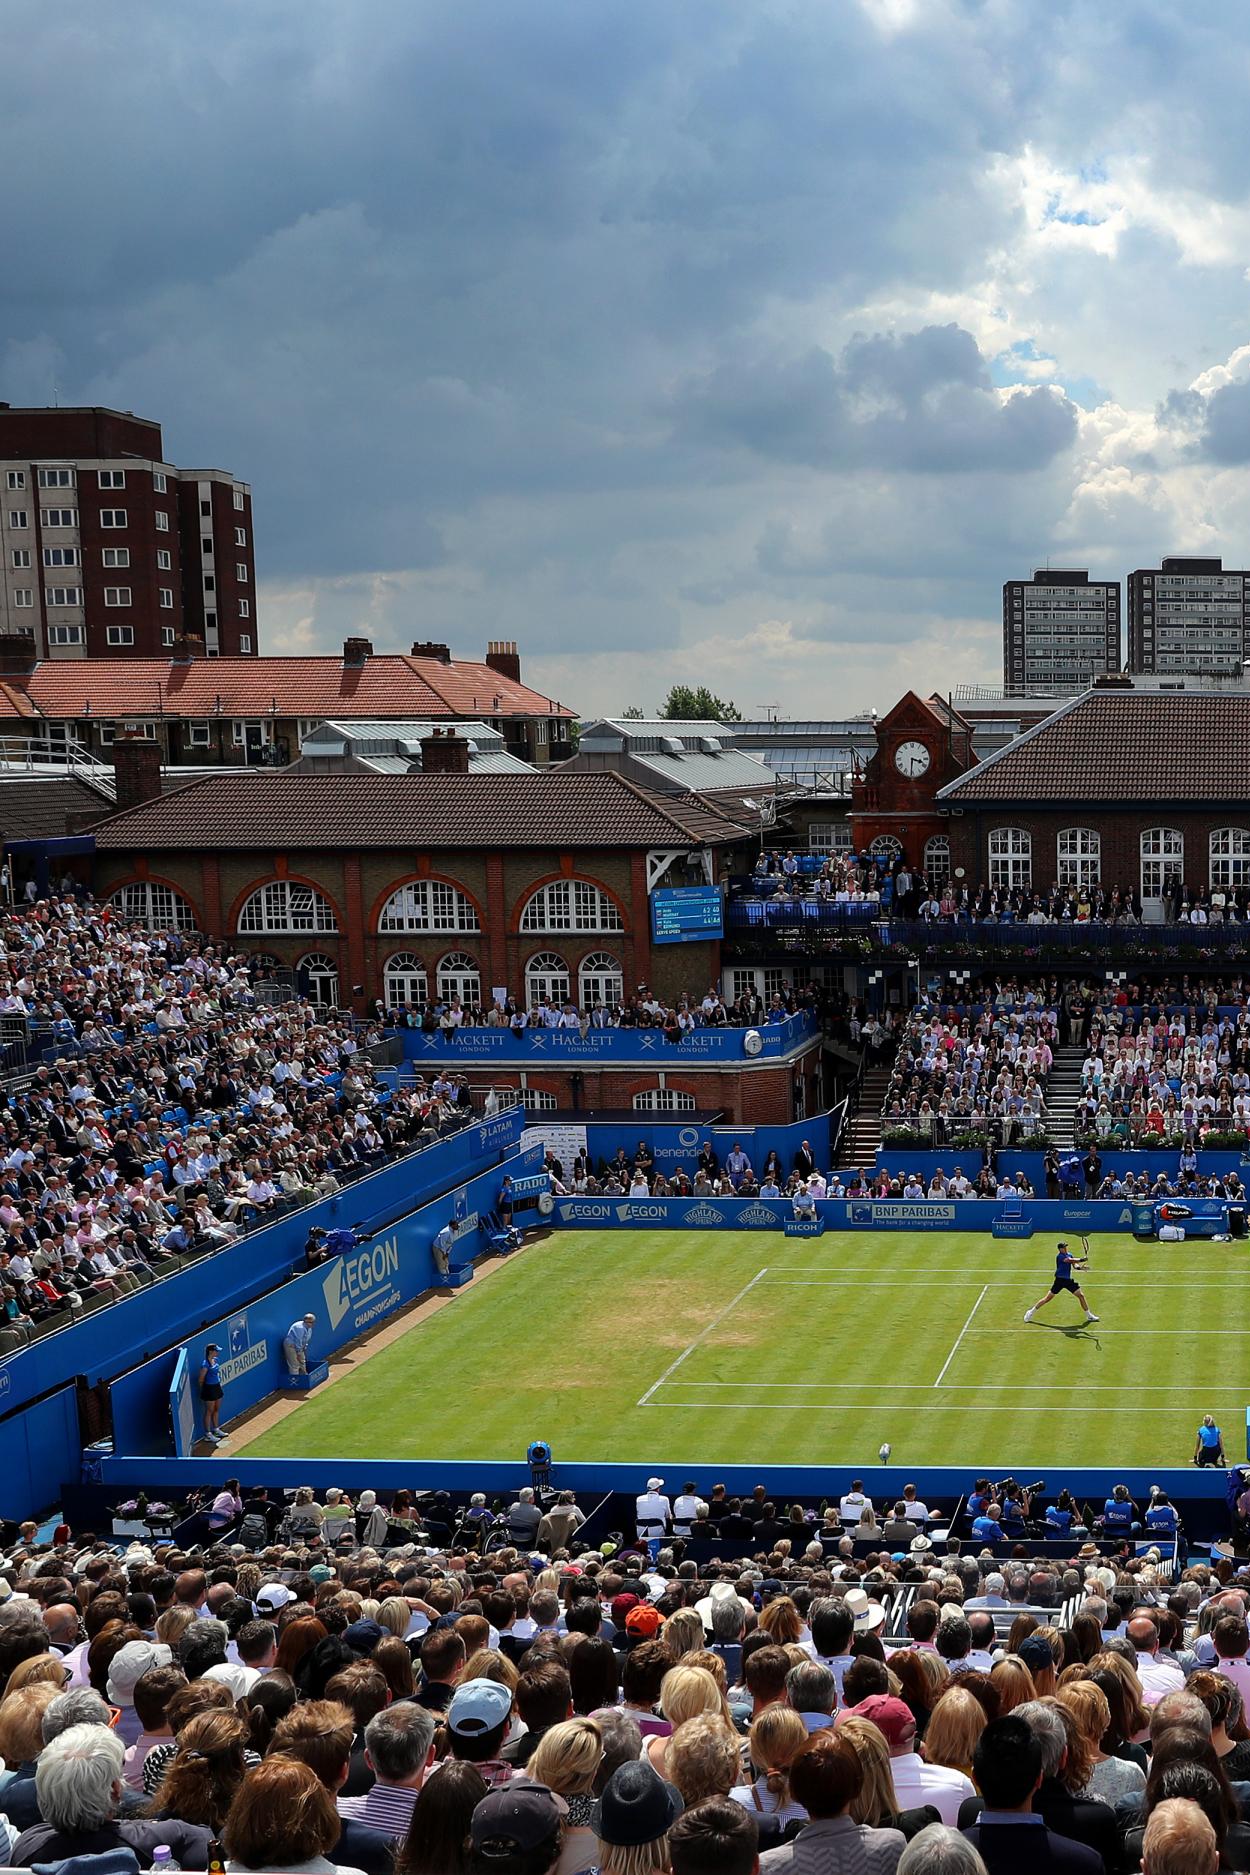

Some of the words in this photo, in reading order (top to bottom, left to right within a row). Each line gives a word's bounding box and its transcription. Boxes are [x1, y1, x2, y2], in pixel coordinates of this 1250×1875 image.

[552, 1034, 614, 1046] HACKETT
[488, 1119, 513, 1137] LATAM
[653, 1146, 704, 1158] benende
[514, 1176, 547, 1192] RADO
[564, 1204, 611, 1218] AEGON
[620, 1204, 668, 1218] AEGON
[684, 1208, 723, 1223] HIGHLAND
[737, 1208, 776, 1223] HIGHLAND
[875, 1206, 898, 1216] BNP
[902, 1206, 950, 1217] PARIBAS
[1063, 1210, 1092, 1218] Europcar
[332, 1236, 398, 1318] AEGON
[355, 1289, 400, 1328] CHAMPIONSHIPS
[234, 1344, 265, 1375] PARIBAS
